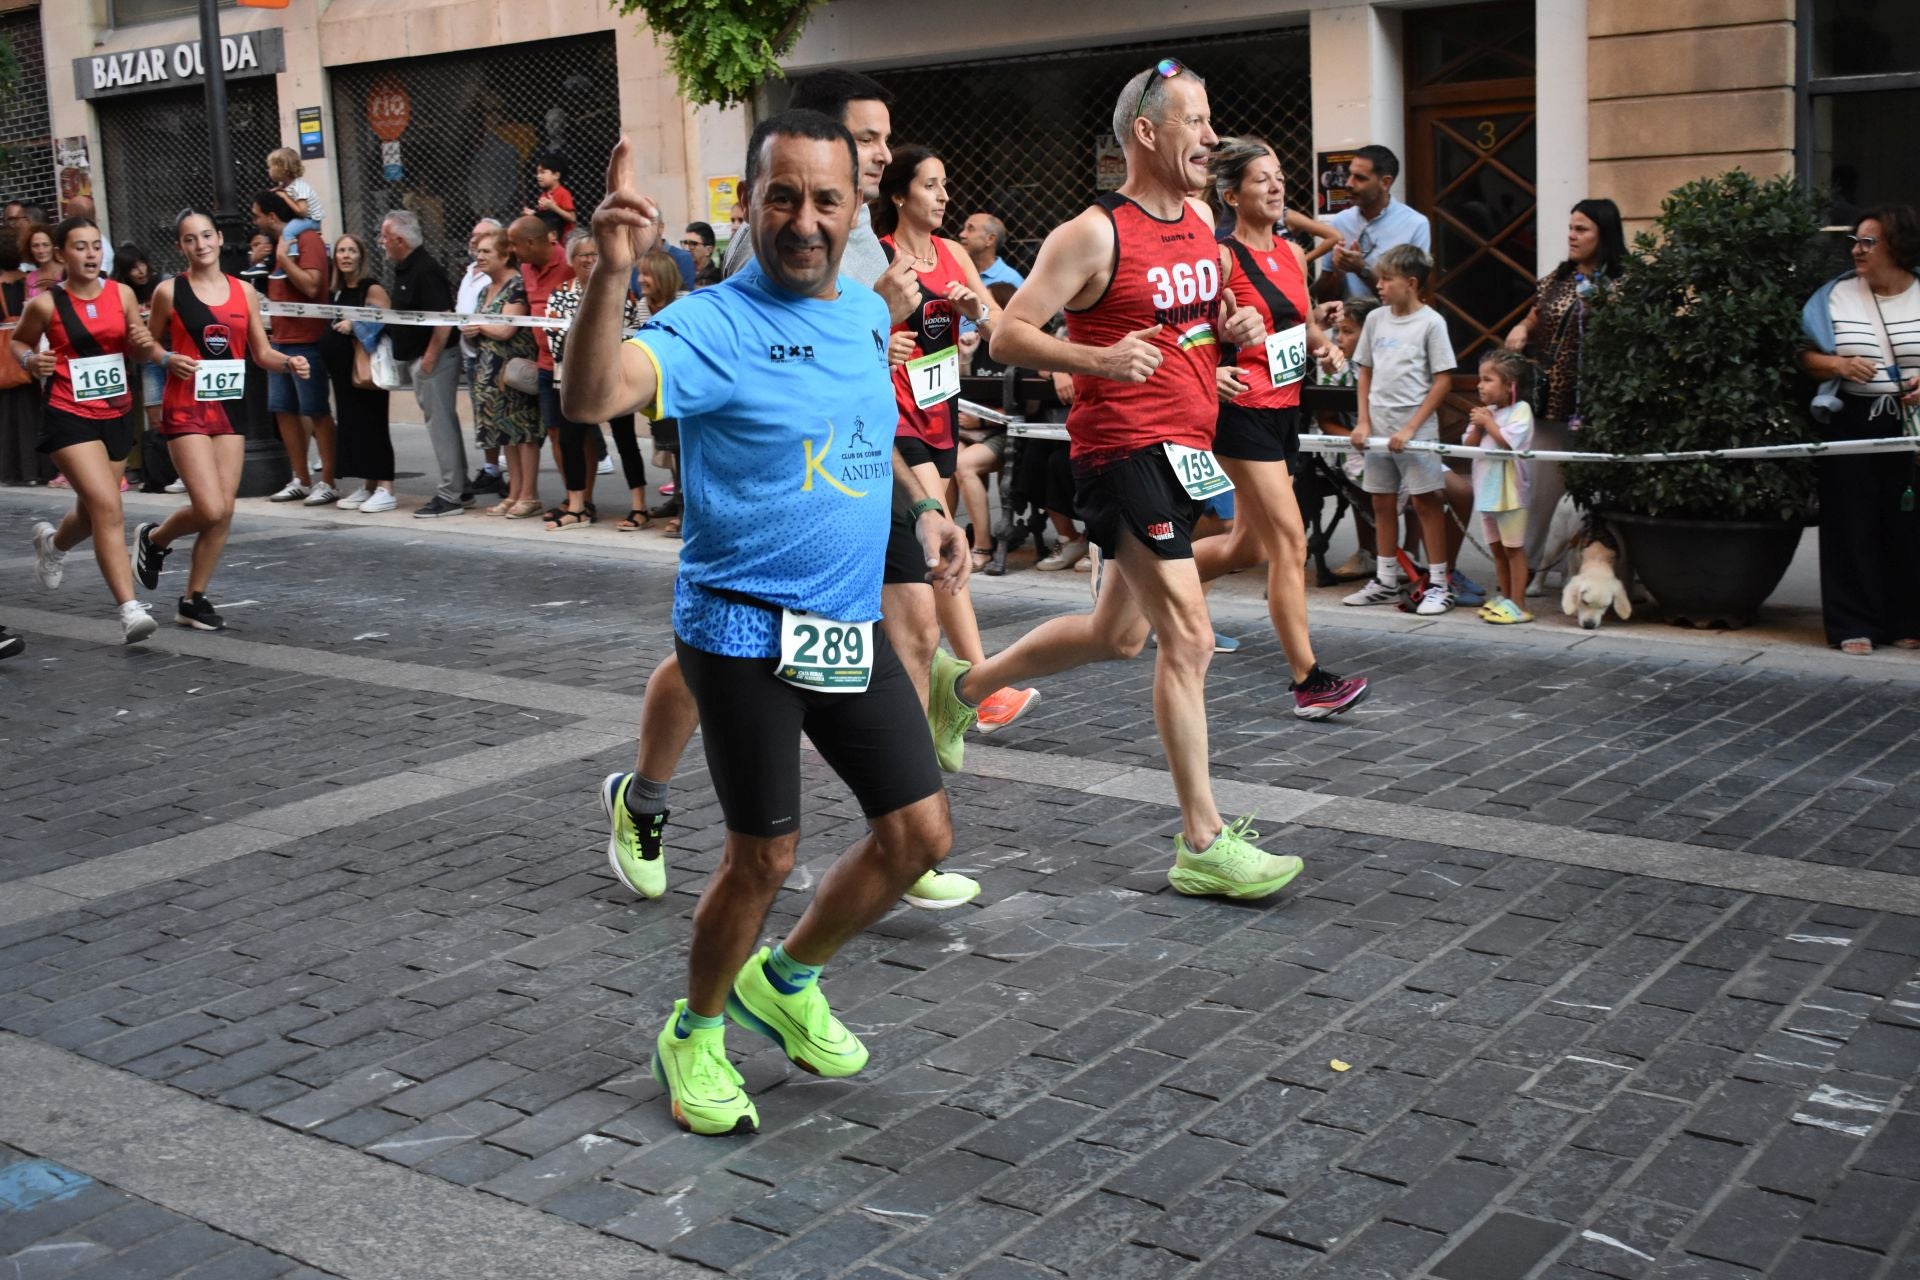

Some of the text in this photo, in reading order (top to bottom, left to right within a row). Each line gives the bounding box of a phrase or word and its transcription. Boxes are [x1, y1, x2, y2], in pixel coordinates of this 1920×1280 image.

[91, 35, 259, 90] BAZAR OUDA
[1477, 121, 1496, 149] 3
[1147, 259, 1218, 309] 360
[925, 316, 951, 326] LODOSA
[79, 367, 121, 388] 166
[202, 372, 240, 390] 167
[923, 363, 941, 391] 77
[1177, 451, 1215, 483] 159
[1147, 522, 1169, 535] 360
[793, 624, 864, 665] 289
